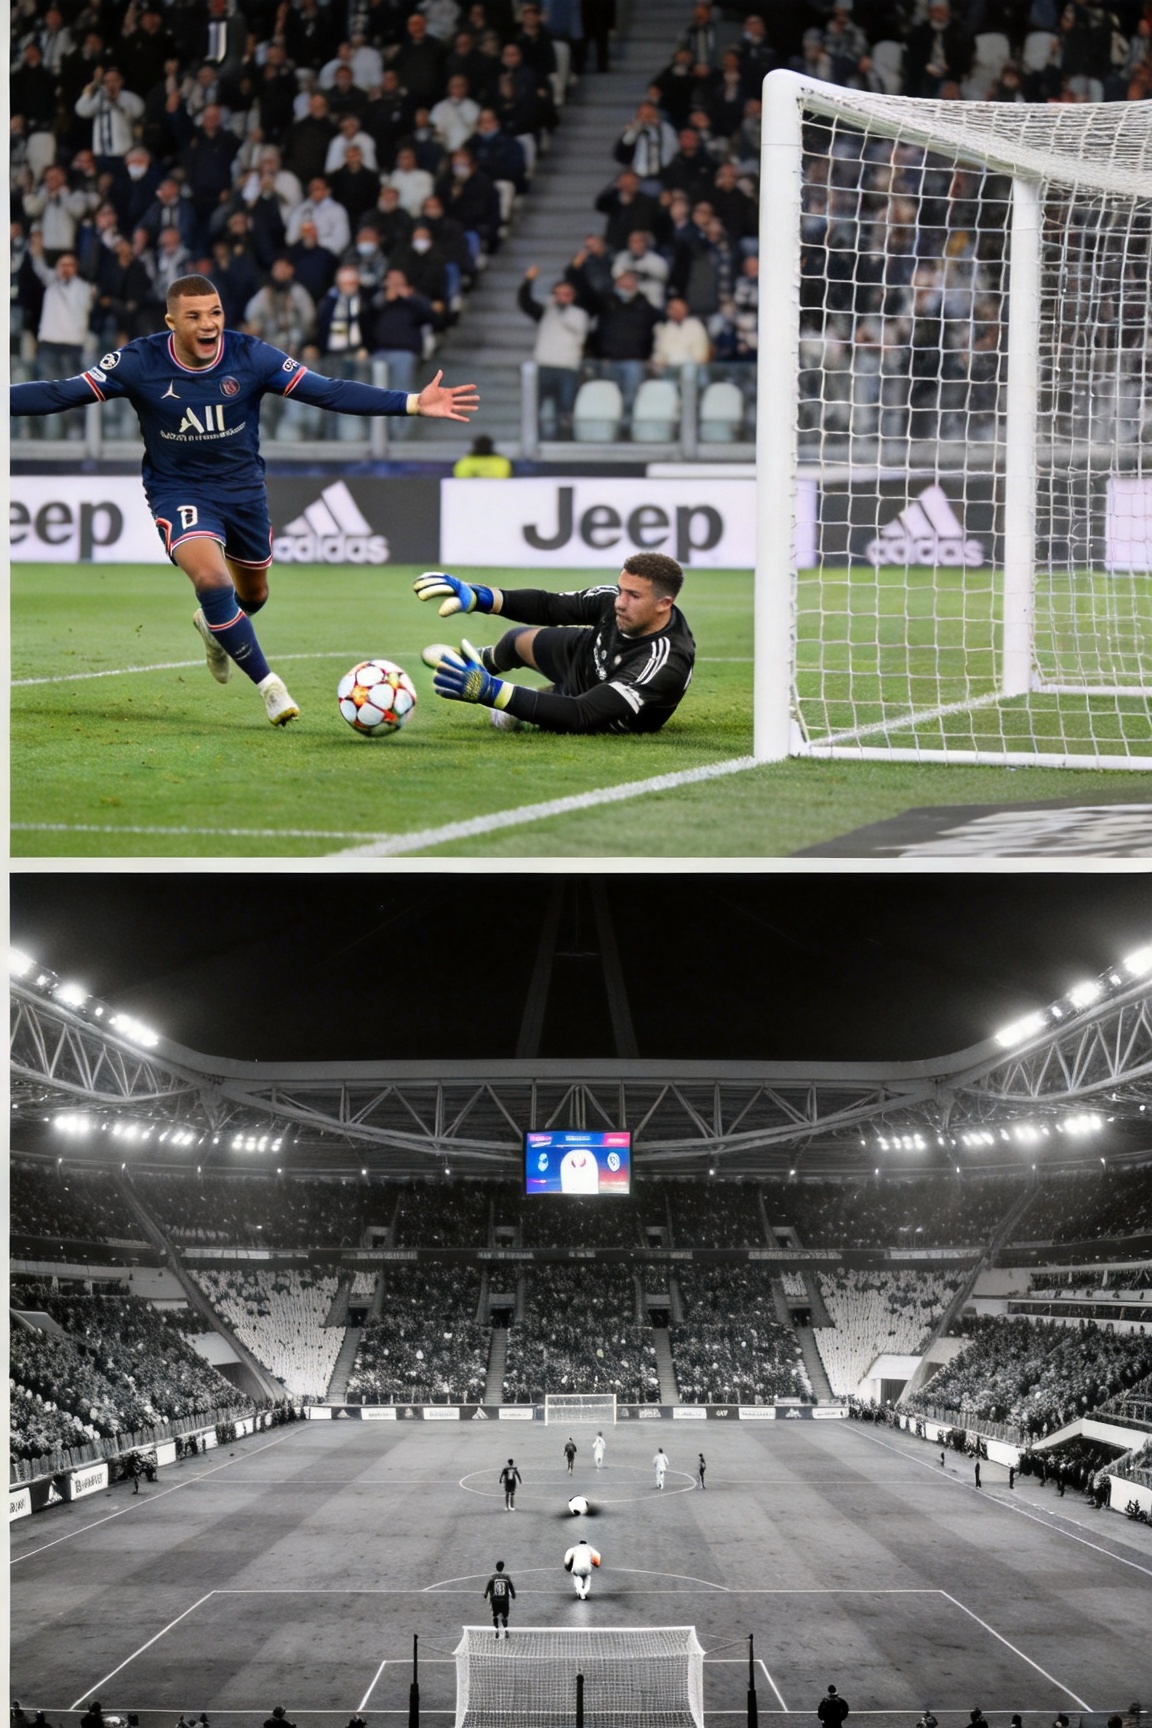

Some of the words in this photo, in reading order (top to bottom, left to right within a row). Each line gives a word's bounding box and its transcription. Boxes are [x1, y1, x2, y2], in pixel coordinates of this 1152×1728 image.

[522, 486, 724, 564] Jeep
[273, 535, 390, 564] adidas
[866, 538, 984, 567] adidas
